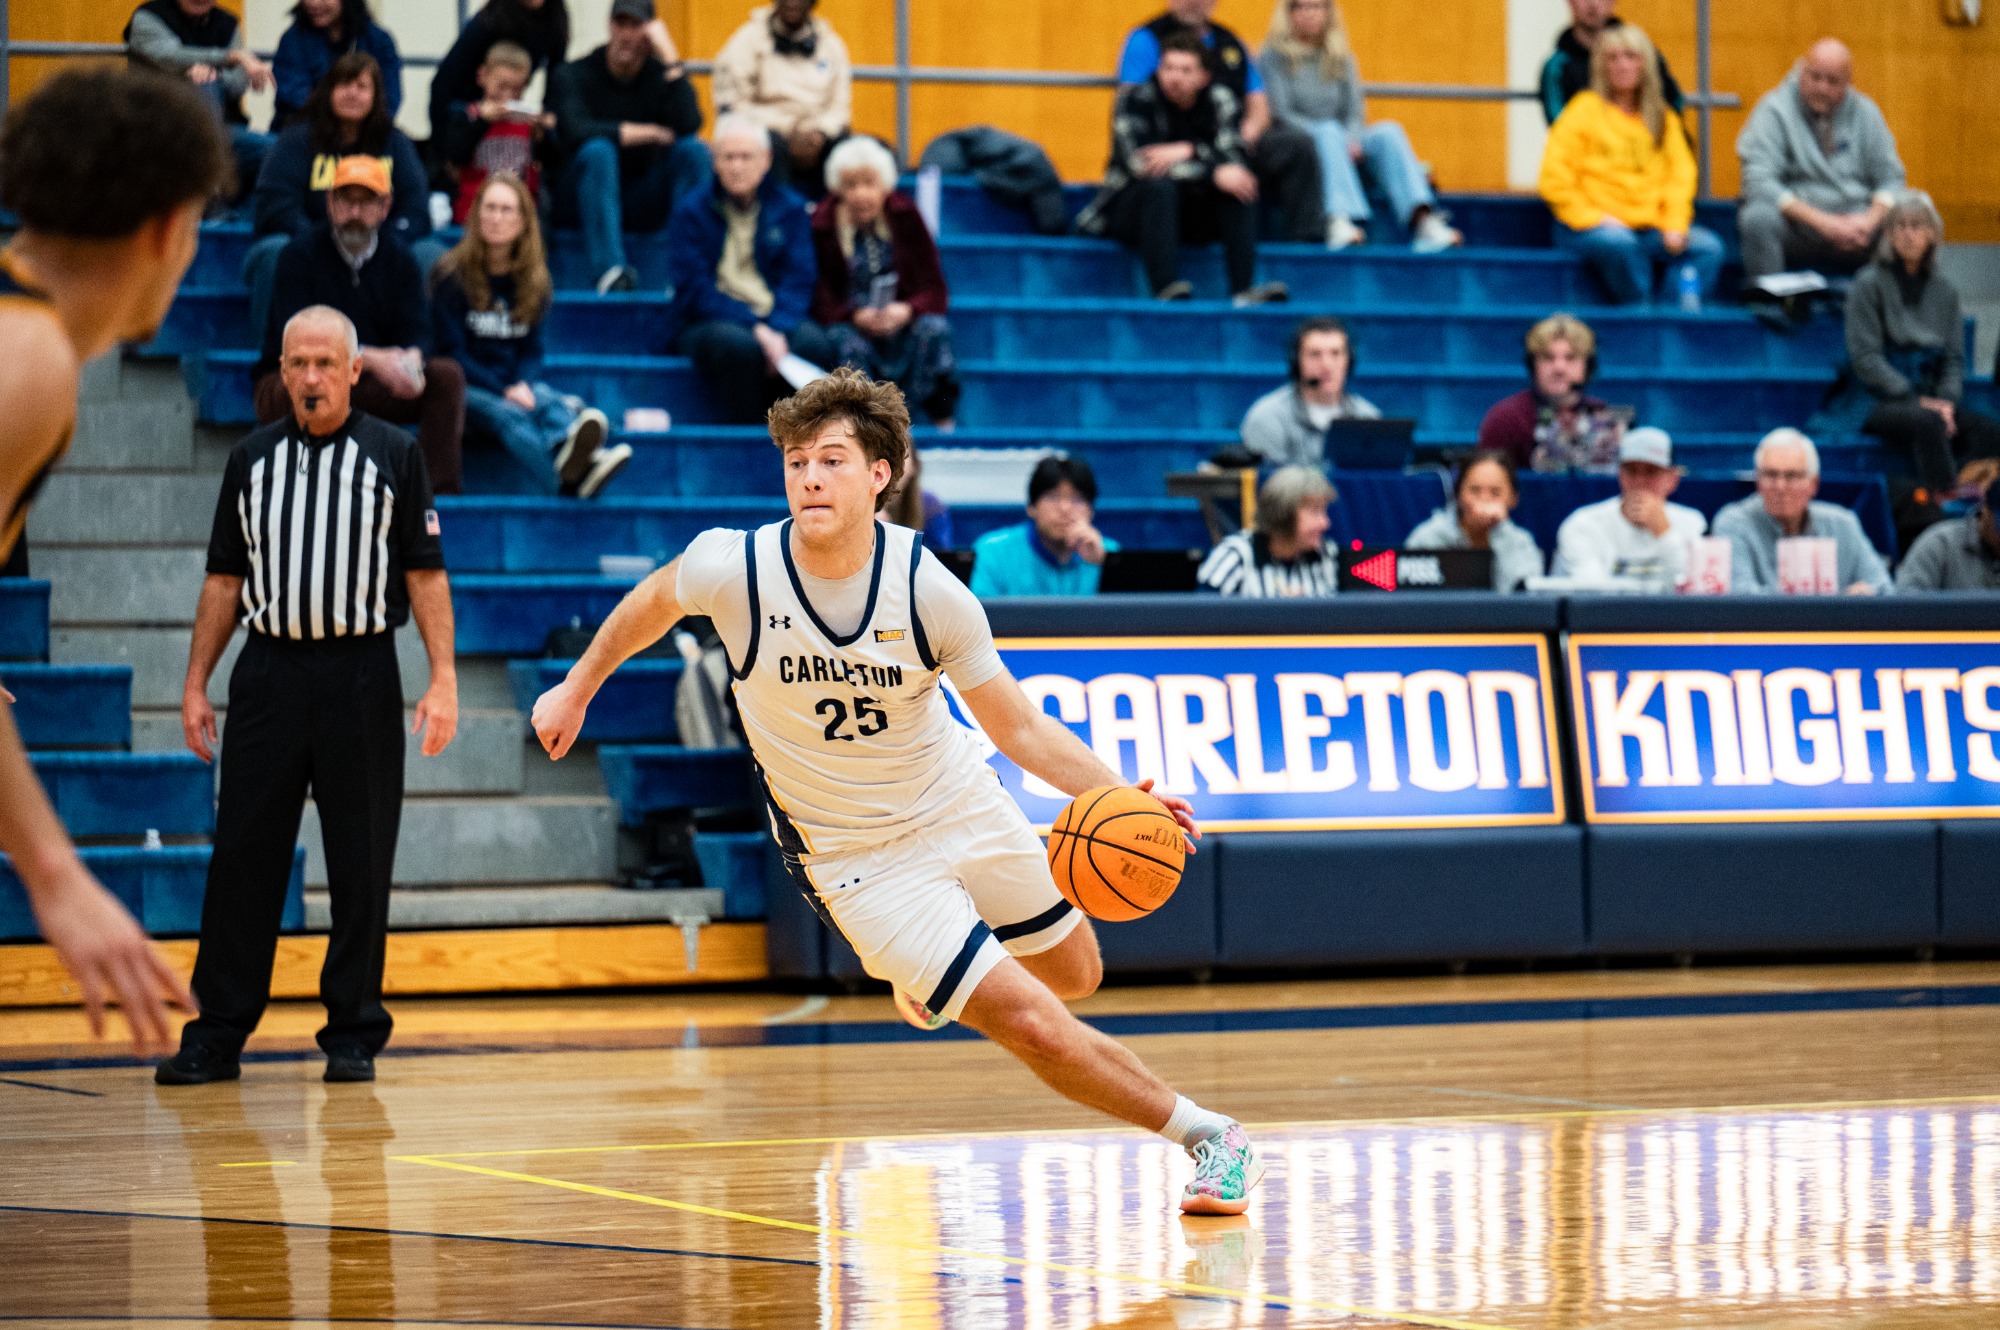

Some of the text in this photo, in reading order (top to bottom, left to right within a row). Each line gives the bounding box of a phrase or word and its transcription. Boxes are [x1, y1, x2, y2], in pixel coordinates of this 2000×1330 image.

[876, 630, 904, 642] MIAC
[780, 655, 903, 688] CARLETON
[815, 697, 888, 741] 25
[1588, 666, 2000, 787] KNIGHTS
[1134, 833, 1152, 842] NXT
